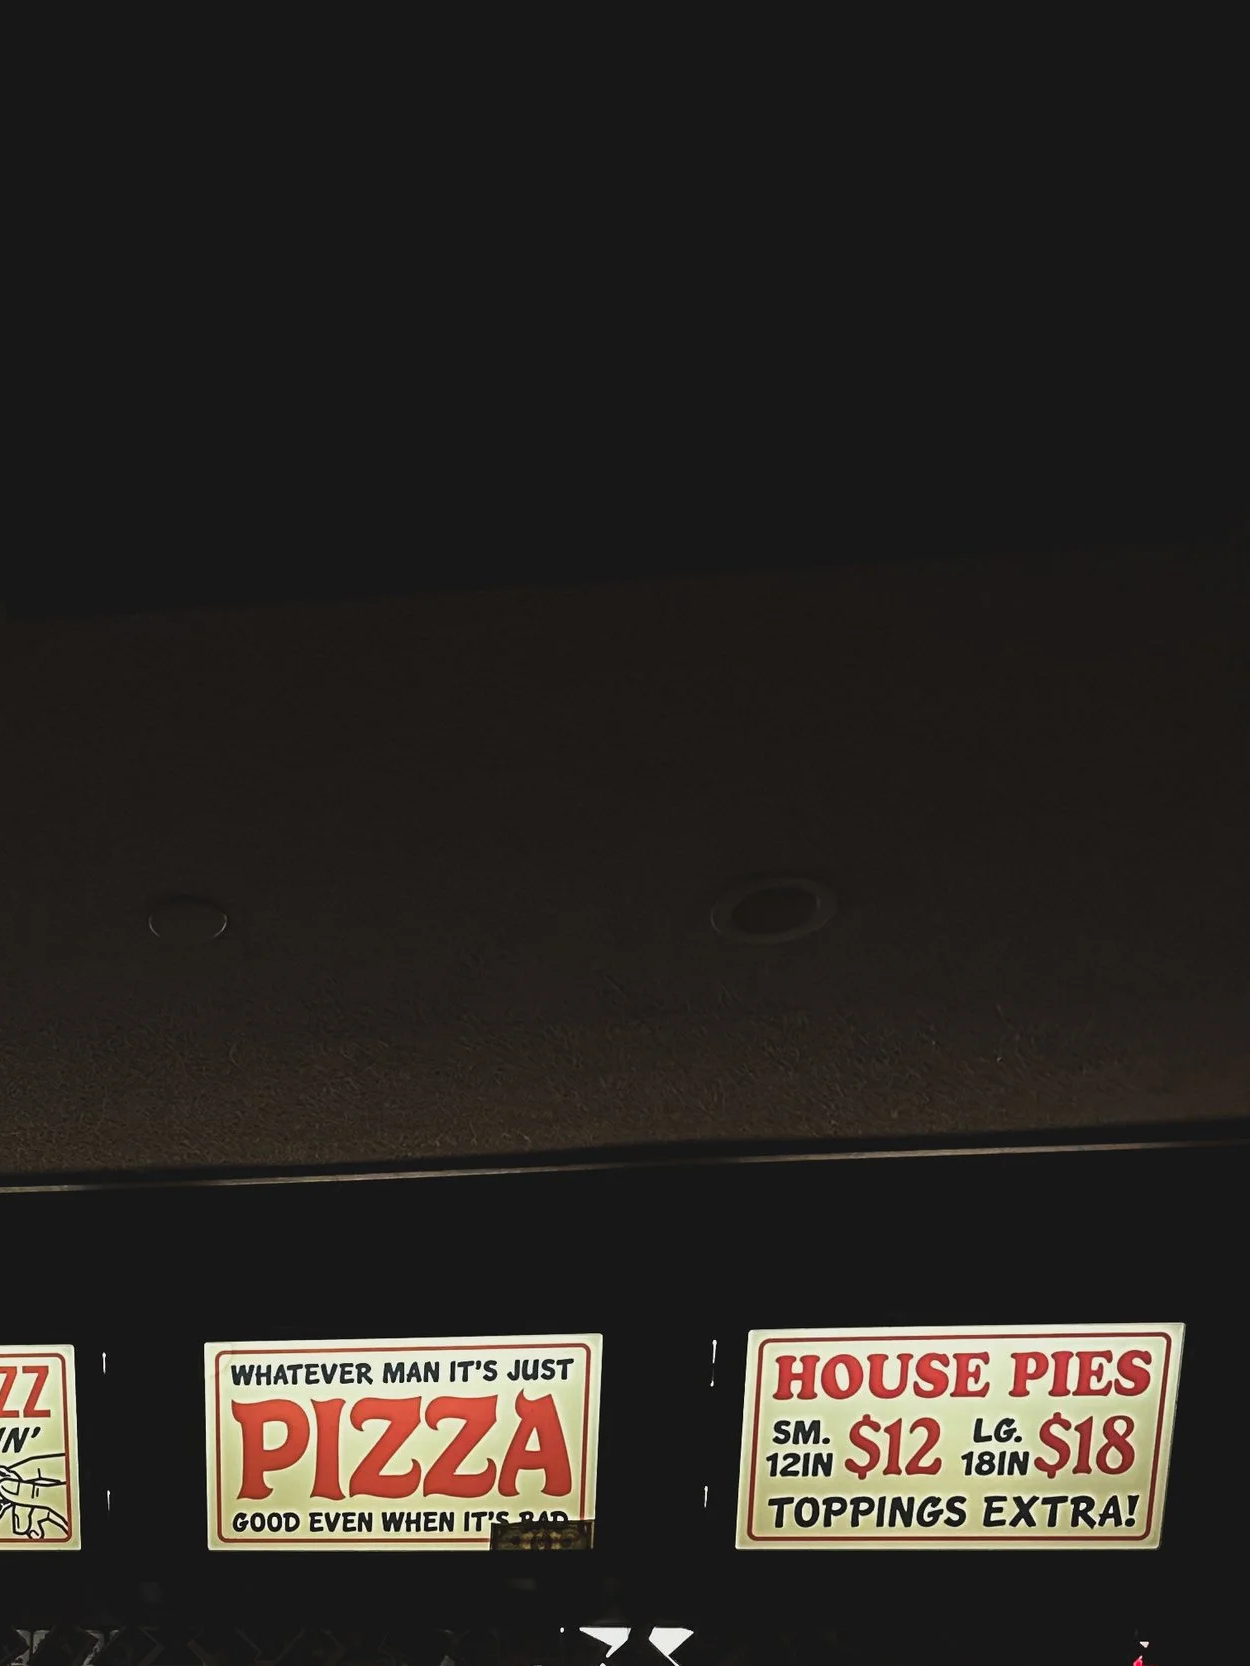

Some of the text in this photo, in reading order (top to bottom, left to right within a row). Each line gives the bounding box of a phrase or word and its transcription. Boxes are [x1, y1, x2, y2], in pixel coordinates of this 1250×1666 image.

[231, 1359, 574, 1385] WHATEVER MAN IT'S JUST
[773, 1350, 1151, 1400] HOUSE PIES
[773, 1420, 830, 1445] SM.
[974, 1418, 1022, 1443] LG.
[231, 1388, 572, 1501] PIZZA
[845, 1414, 942, 1480] $12
[1034, 1412, 1135, 1479] $18
[766, 1453, 833, 1477] 12IN
[961, 1451, 1029, 1475] 18IN
[231, 1510, 301, 1533] GOOD
[309, 1510, 374, 1533] EVEN
[380, 1510, 456, 1533] WHEN
[768, 1494, 1140, 1530] TOPPINGS EXTRA!
